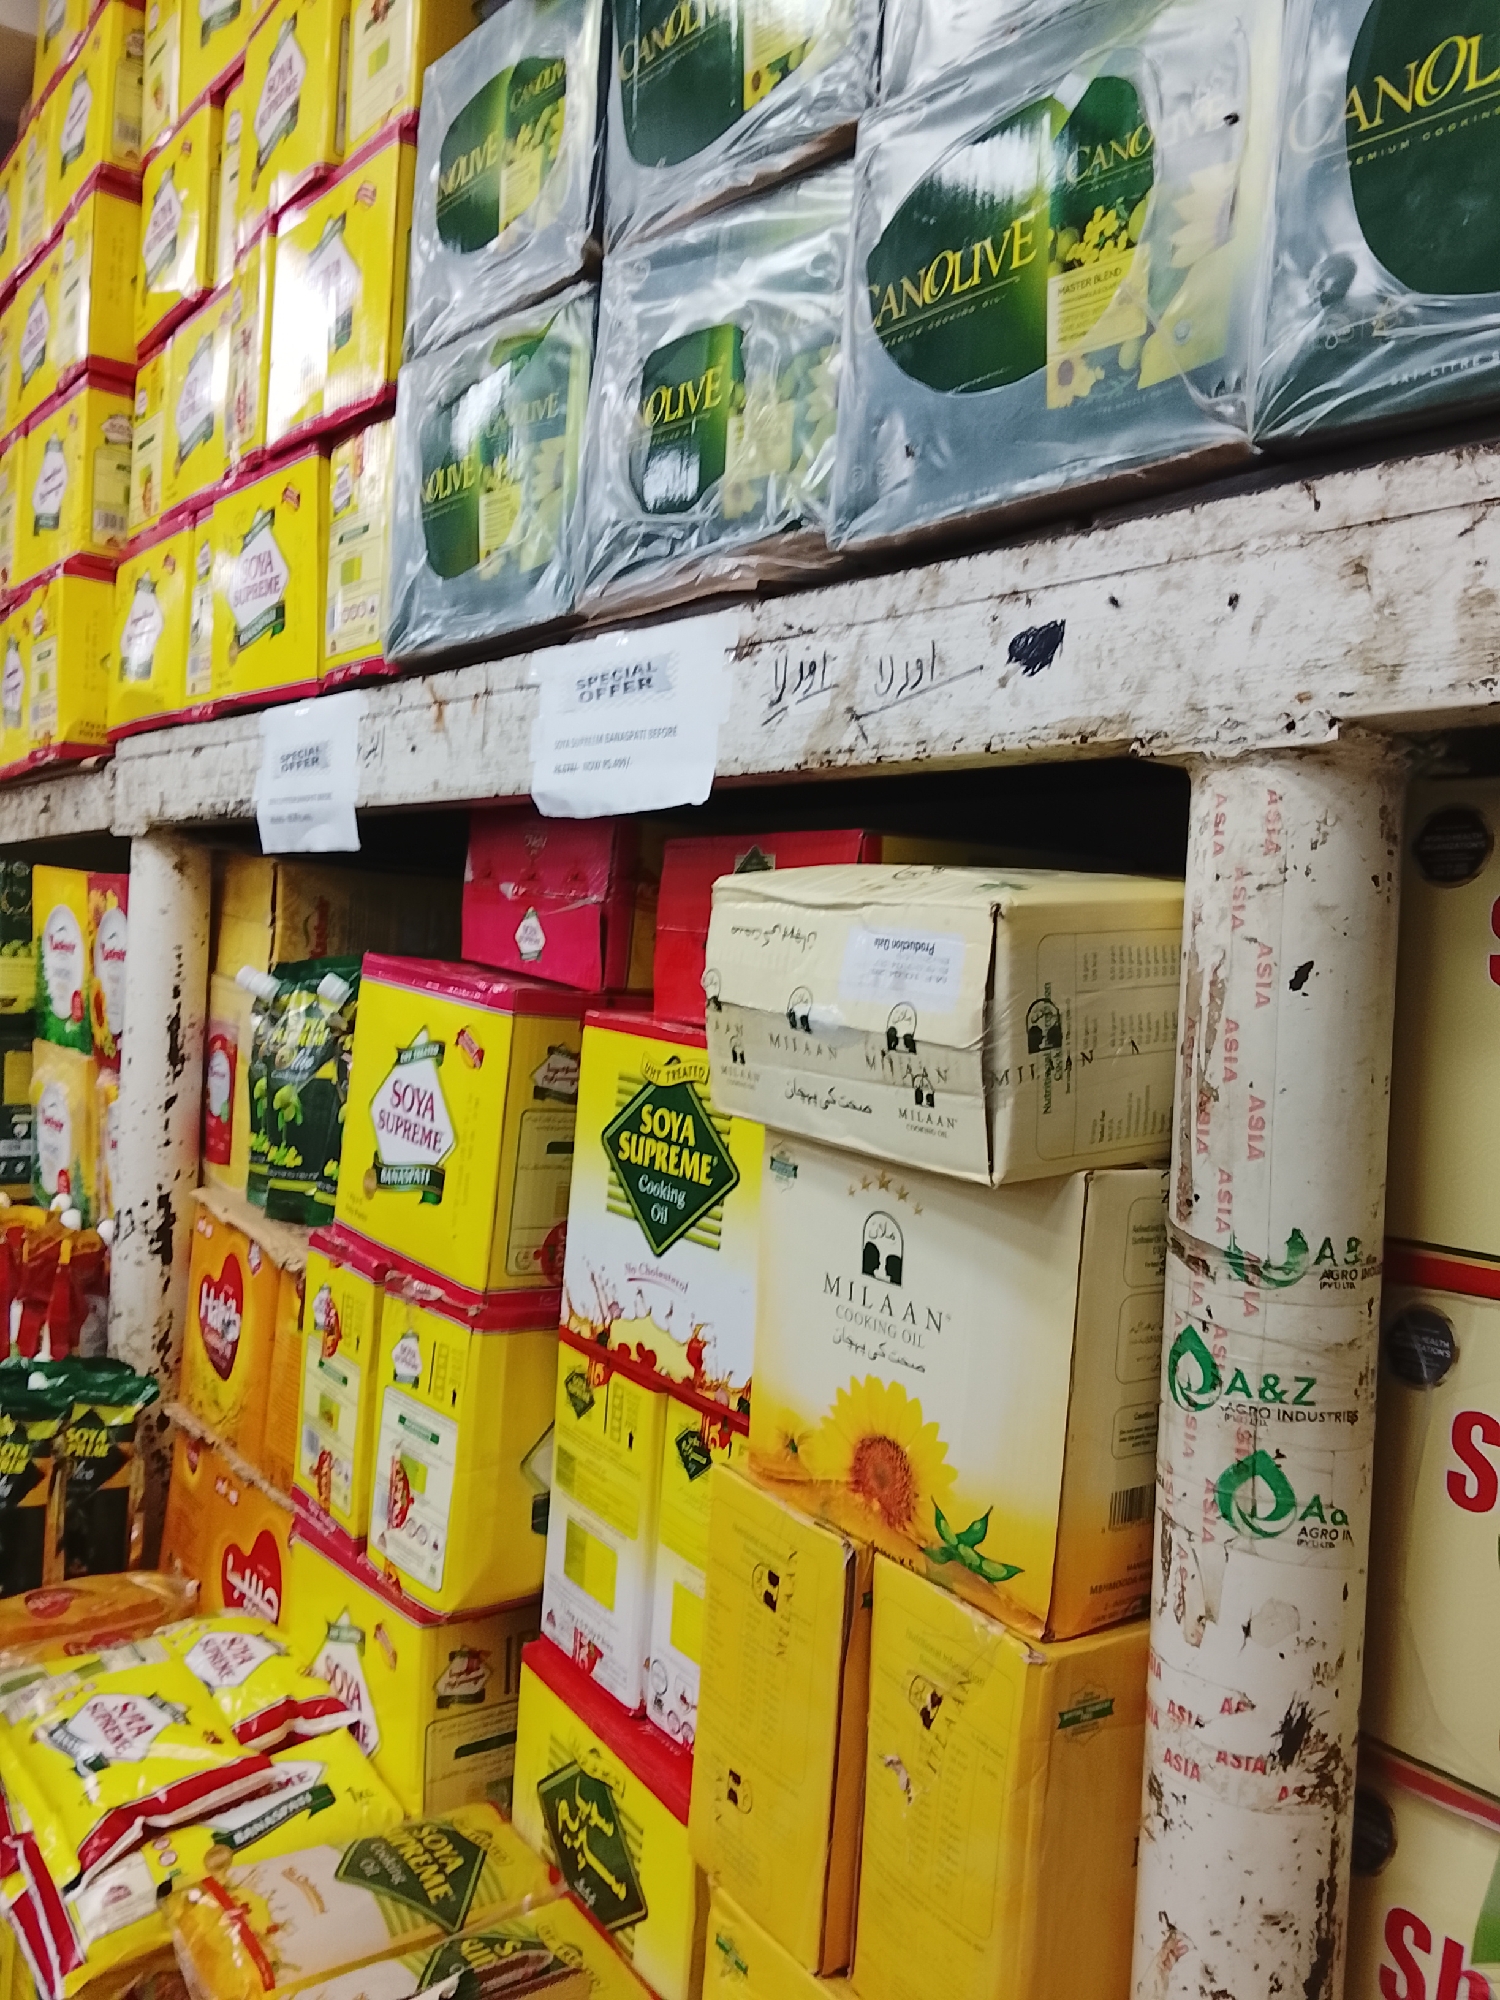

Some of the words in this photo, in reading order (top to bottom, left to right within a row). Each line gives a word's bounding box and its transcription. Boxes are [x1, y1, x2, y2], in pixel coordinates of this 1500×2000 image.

[1058, 277, 1092, 298] MASTER
[1094, 267, 1122, 285] BLEND
[576, 661, 658, 690] SPECIAL
[578, 676, 654, 703] OFFER
[280, 745, 320, 764] SPECIAL
[280, 756, 320, 773] OFFER
[1212, 792, 1228, 859] ASIA
[1263, 788, 1283, 857] ASIA
[1230, 866, 1247, 932] ASIA
[890, 940, 936, 956] Production
[1255, 941, 1273, 1010] ASIA
[769, 1032, 838, 1060] MILAAN
[1222, 1017, 1240, 1084] ASIA
[665, 1065, 706, 1084] TREATED
[390, 1078, 436, 1124] SOYA
[898, 1107, 955, 1130] MILAAN
[377, 1108, 443, 1154] SUPREME
[639, 1103, 696, 1148] SOYA
[1247, 1094, 1267, 1162] ASIA
[617, 1130, 715, 1187] SUPREME
[637, 1173, 686, 1211] Cooking
[1215, 1167, 1234, 1234] ASIA
[650, 1203, 669, 1226] Oil
[638, 1261, 689, 1294] Cholesterol
[1319, 1269, 1358, 1282] AGRO
[823, 1272, 943, 1334] MILAAN
[835, 1304, 897, 1340] COOKING
[901, 1328, 926, 1349] OIL
[1224, 1368, 1317, 1407] A&Z
[1277, 1408, 1359, 1426] INDUSTRIES
[1201, 1476, 1219, 1544] ASIA
[1297, 1526, 1339, 1542] AGRO
[1163, 1747, 1201, 1783] ASIA
[412, 1825, 465, 1876] SOYA
